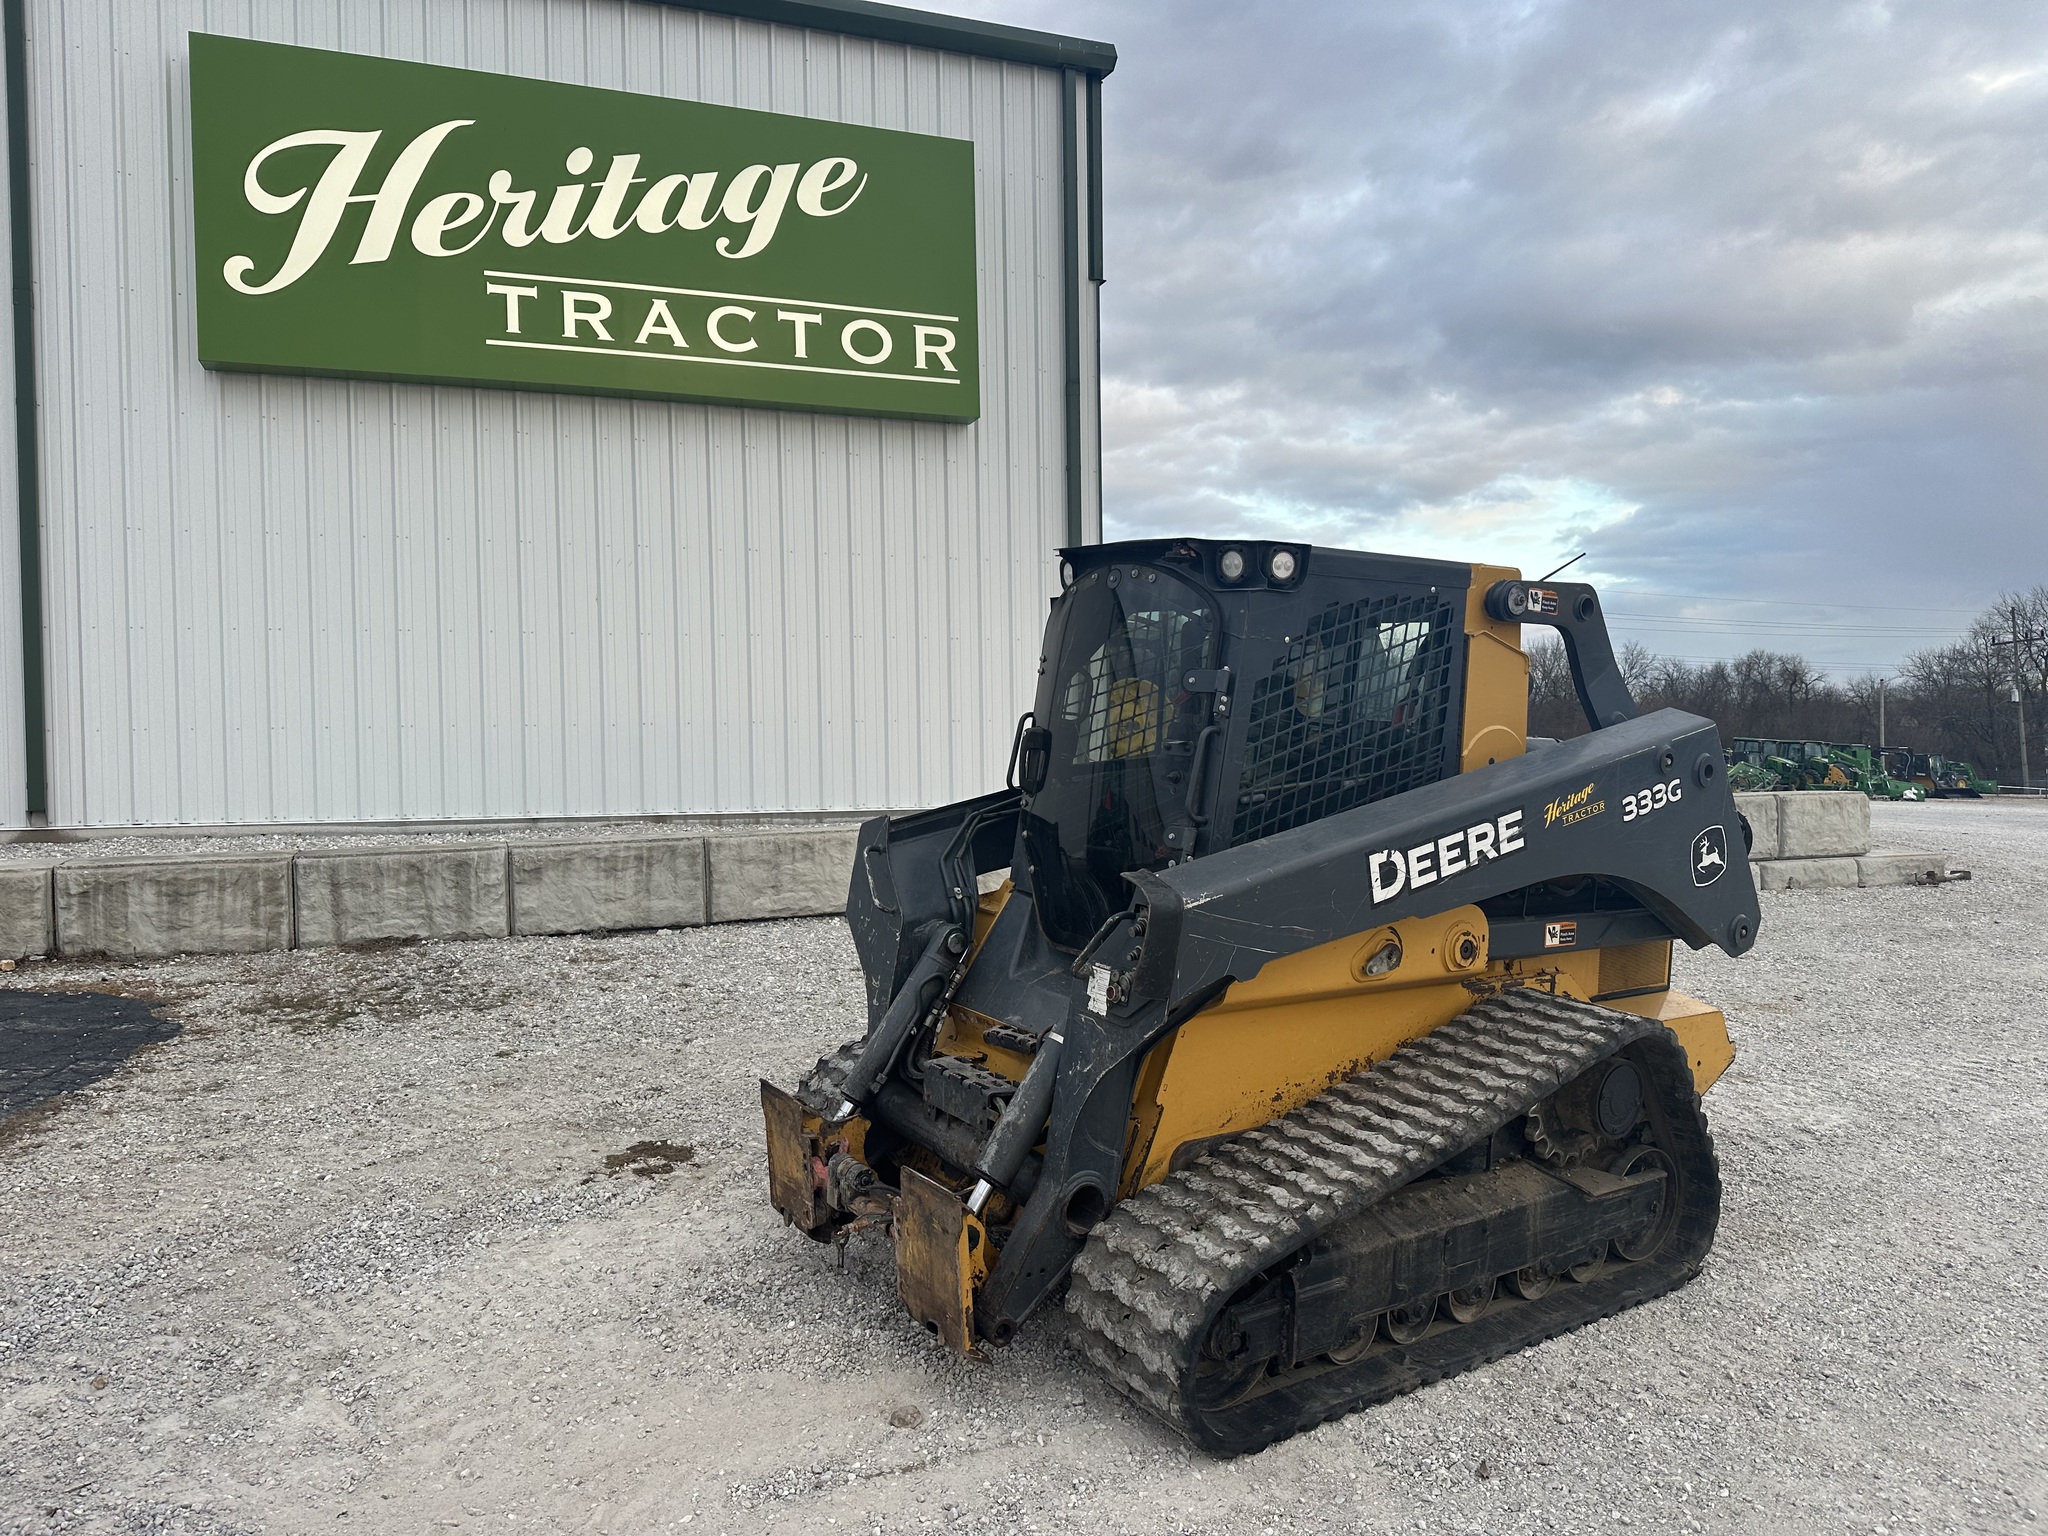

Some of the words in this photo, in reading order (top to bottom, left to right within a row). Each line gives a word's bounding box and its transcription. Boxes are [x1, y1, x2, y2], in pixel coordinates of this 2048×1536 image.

[223, 119, 869, 295] Heritage
[485, 281, 959, 372] TRACTOR
[1544, 782, 1595, 829] Heritage
[1562, 801, 1605, 825] TRACTOR
[1622, 778, 1682, 822] 333G
[1368, 809, 1526, 904] DEERE
